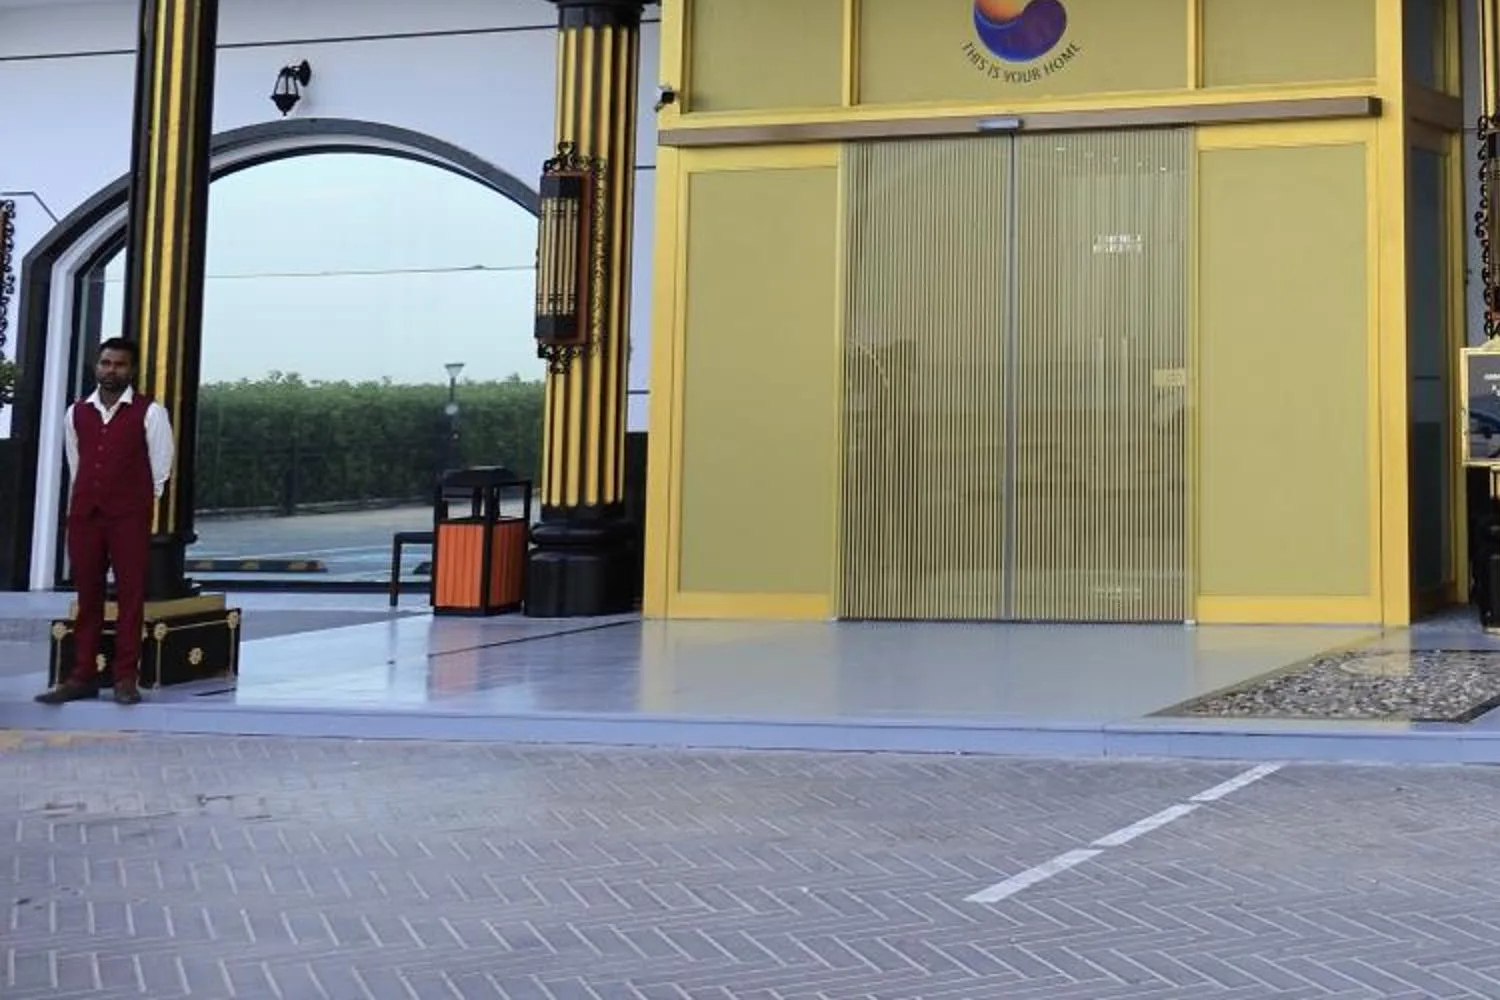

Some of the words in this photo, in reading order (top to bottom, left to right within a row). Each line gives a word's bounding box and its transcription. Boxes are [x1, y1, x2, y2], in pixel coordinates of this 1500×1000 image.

[962, 41, 987, 71] THIS
[987, 65, 999, 79] IS
[1004, 67, 1041, 83] YOUR
[1043, 42, 1081, 75] HOME
